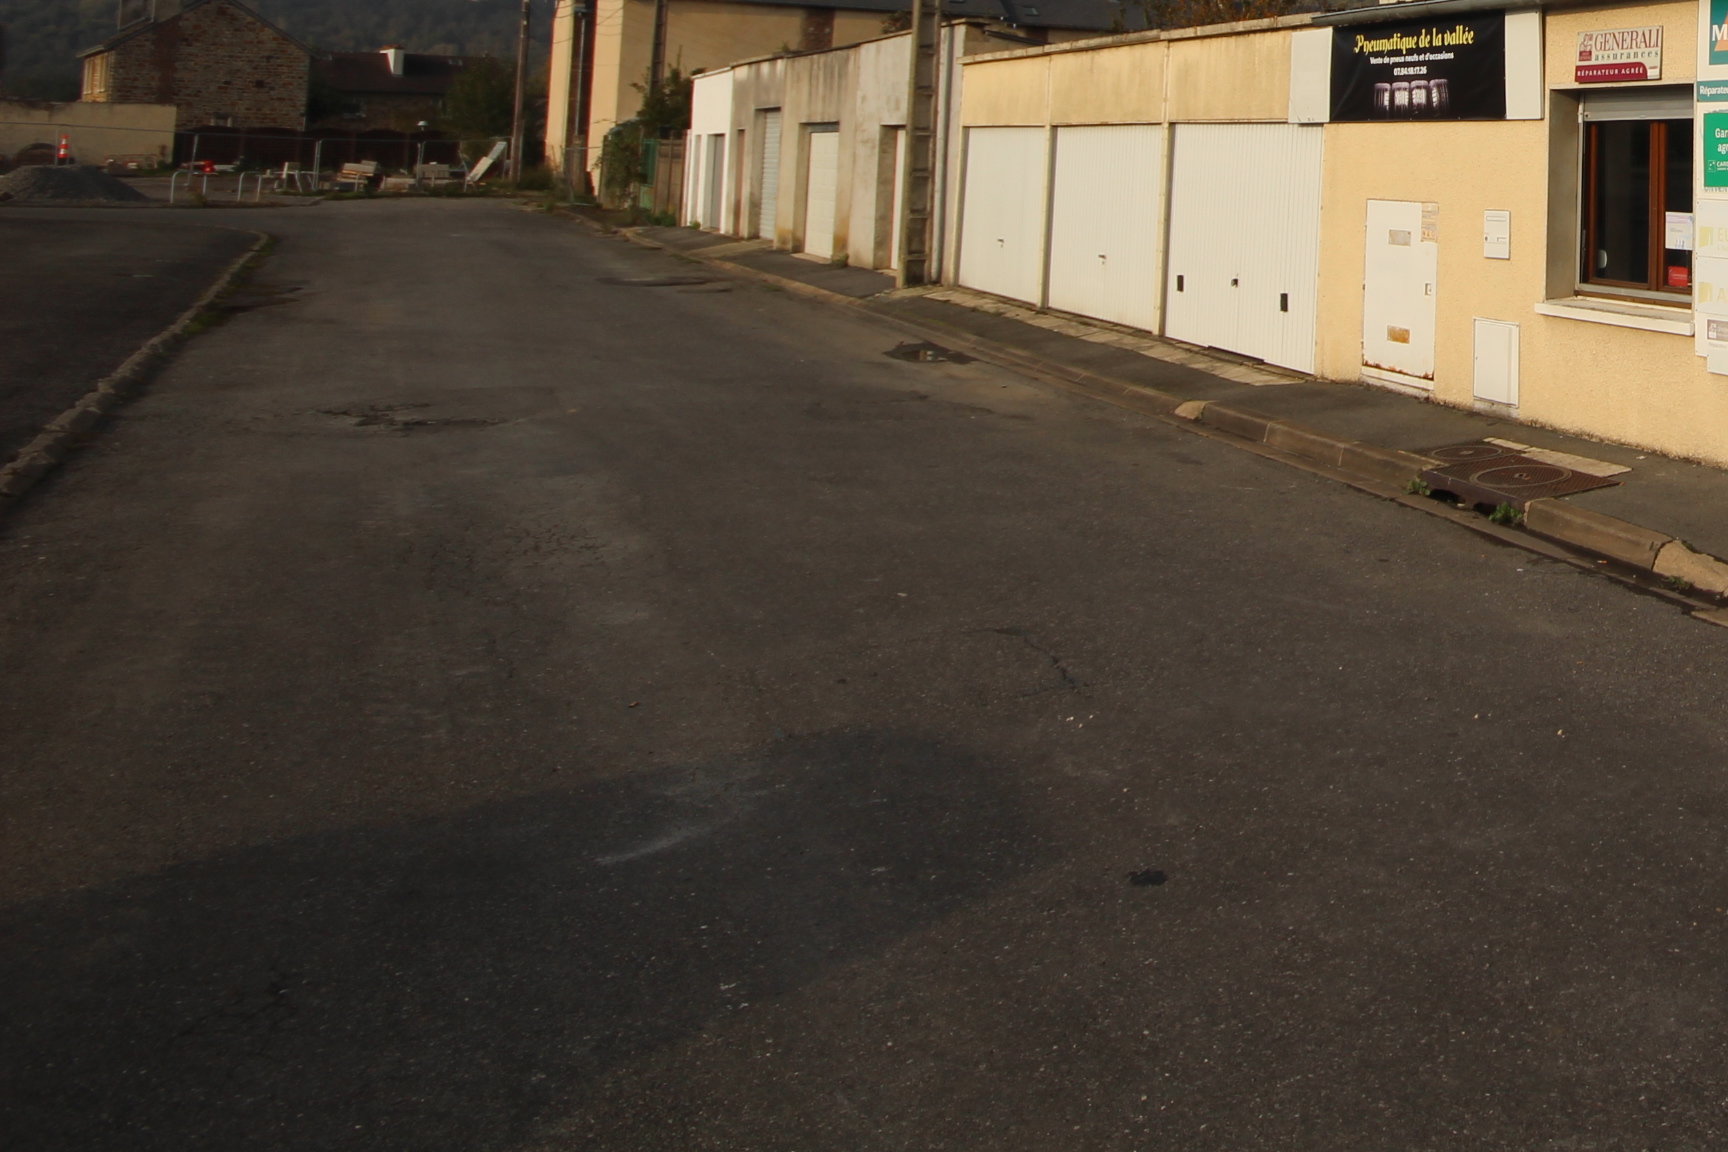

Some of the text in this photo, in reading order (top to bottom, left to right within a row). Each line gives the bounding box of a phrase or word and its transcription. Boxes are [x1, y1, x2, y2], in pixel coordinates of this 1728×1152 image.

[1354, 24, 1474, 54] Pneumatique de la vallée
[1594, 28, 1660, 52] GENERALI
[1595, 51, 1658, 61] assurances
[1577, 66, 1644, 77] RÉPARATEUR AGRÉÉ
